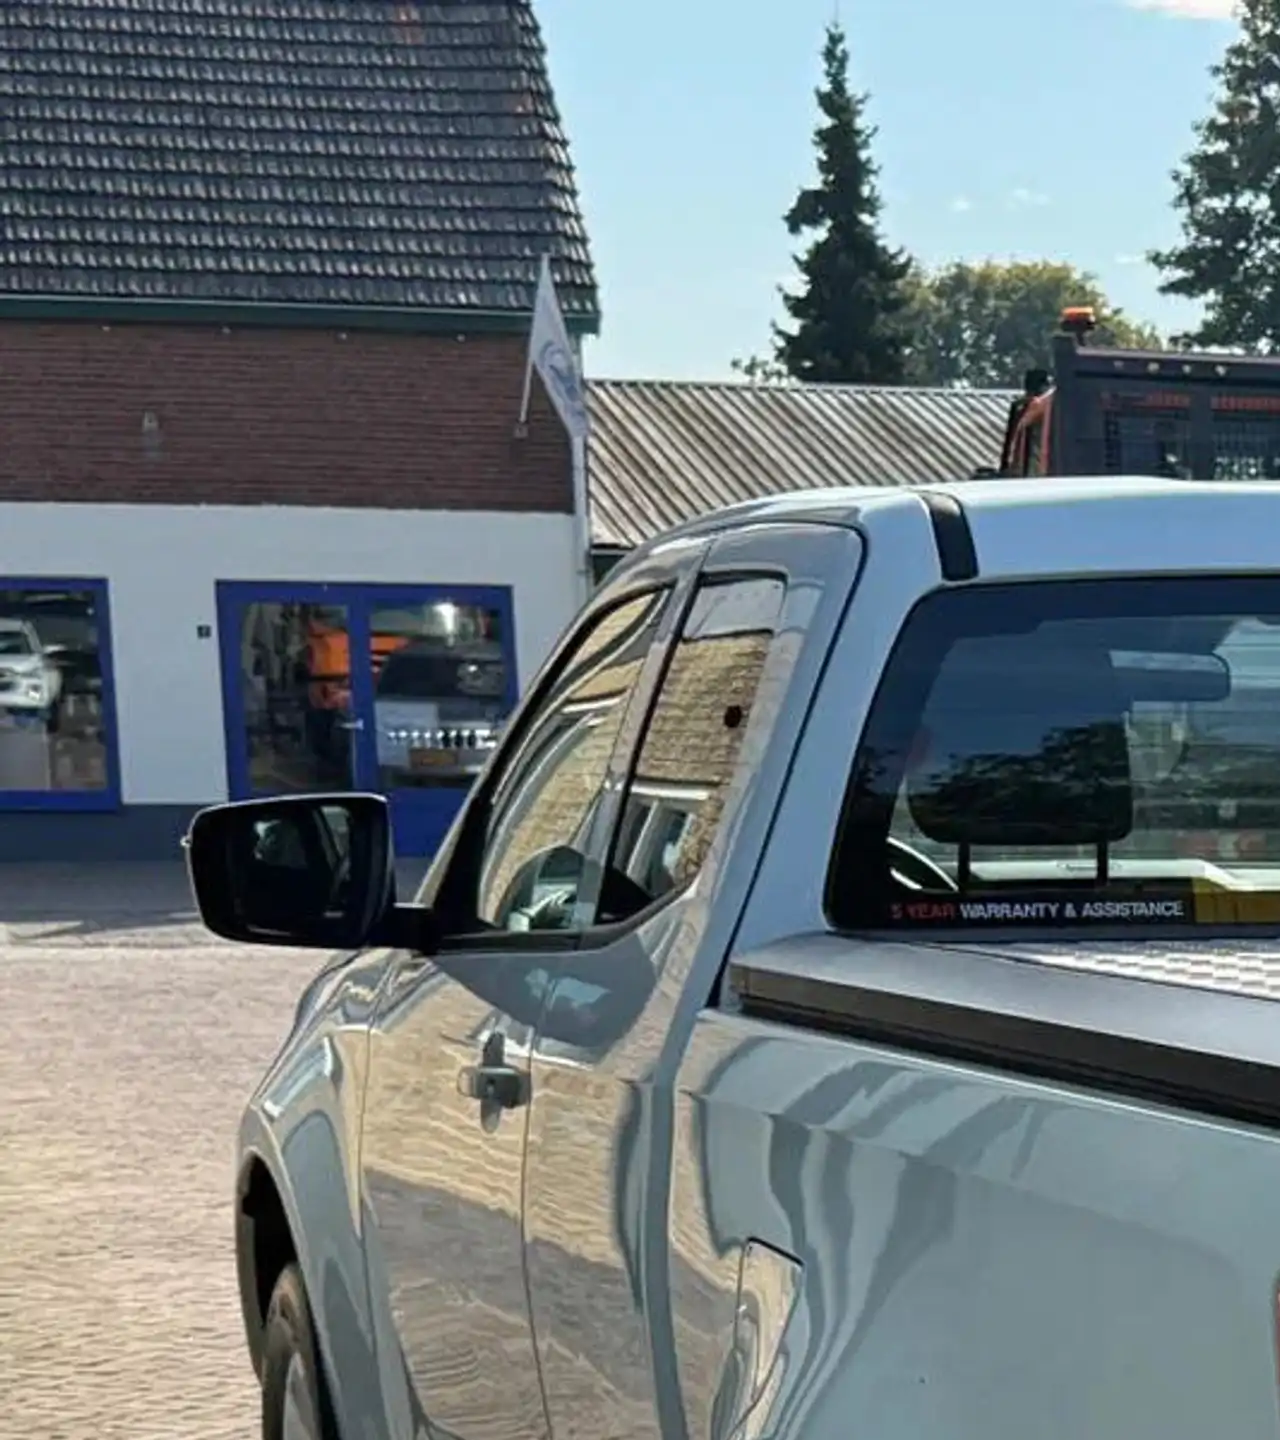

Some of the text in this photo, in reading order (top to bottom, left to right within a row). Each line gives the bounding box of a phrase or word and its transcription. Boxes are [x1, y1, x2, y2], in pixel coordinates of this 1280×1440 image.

[907, 903, 955, 919] YEAR
[960, 902, 1059, 919] WARRANTY
[1065, 902, 1077, 919] &
[1082, 900, 1184, 918] ASSISTANCE
